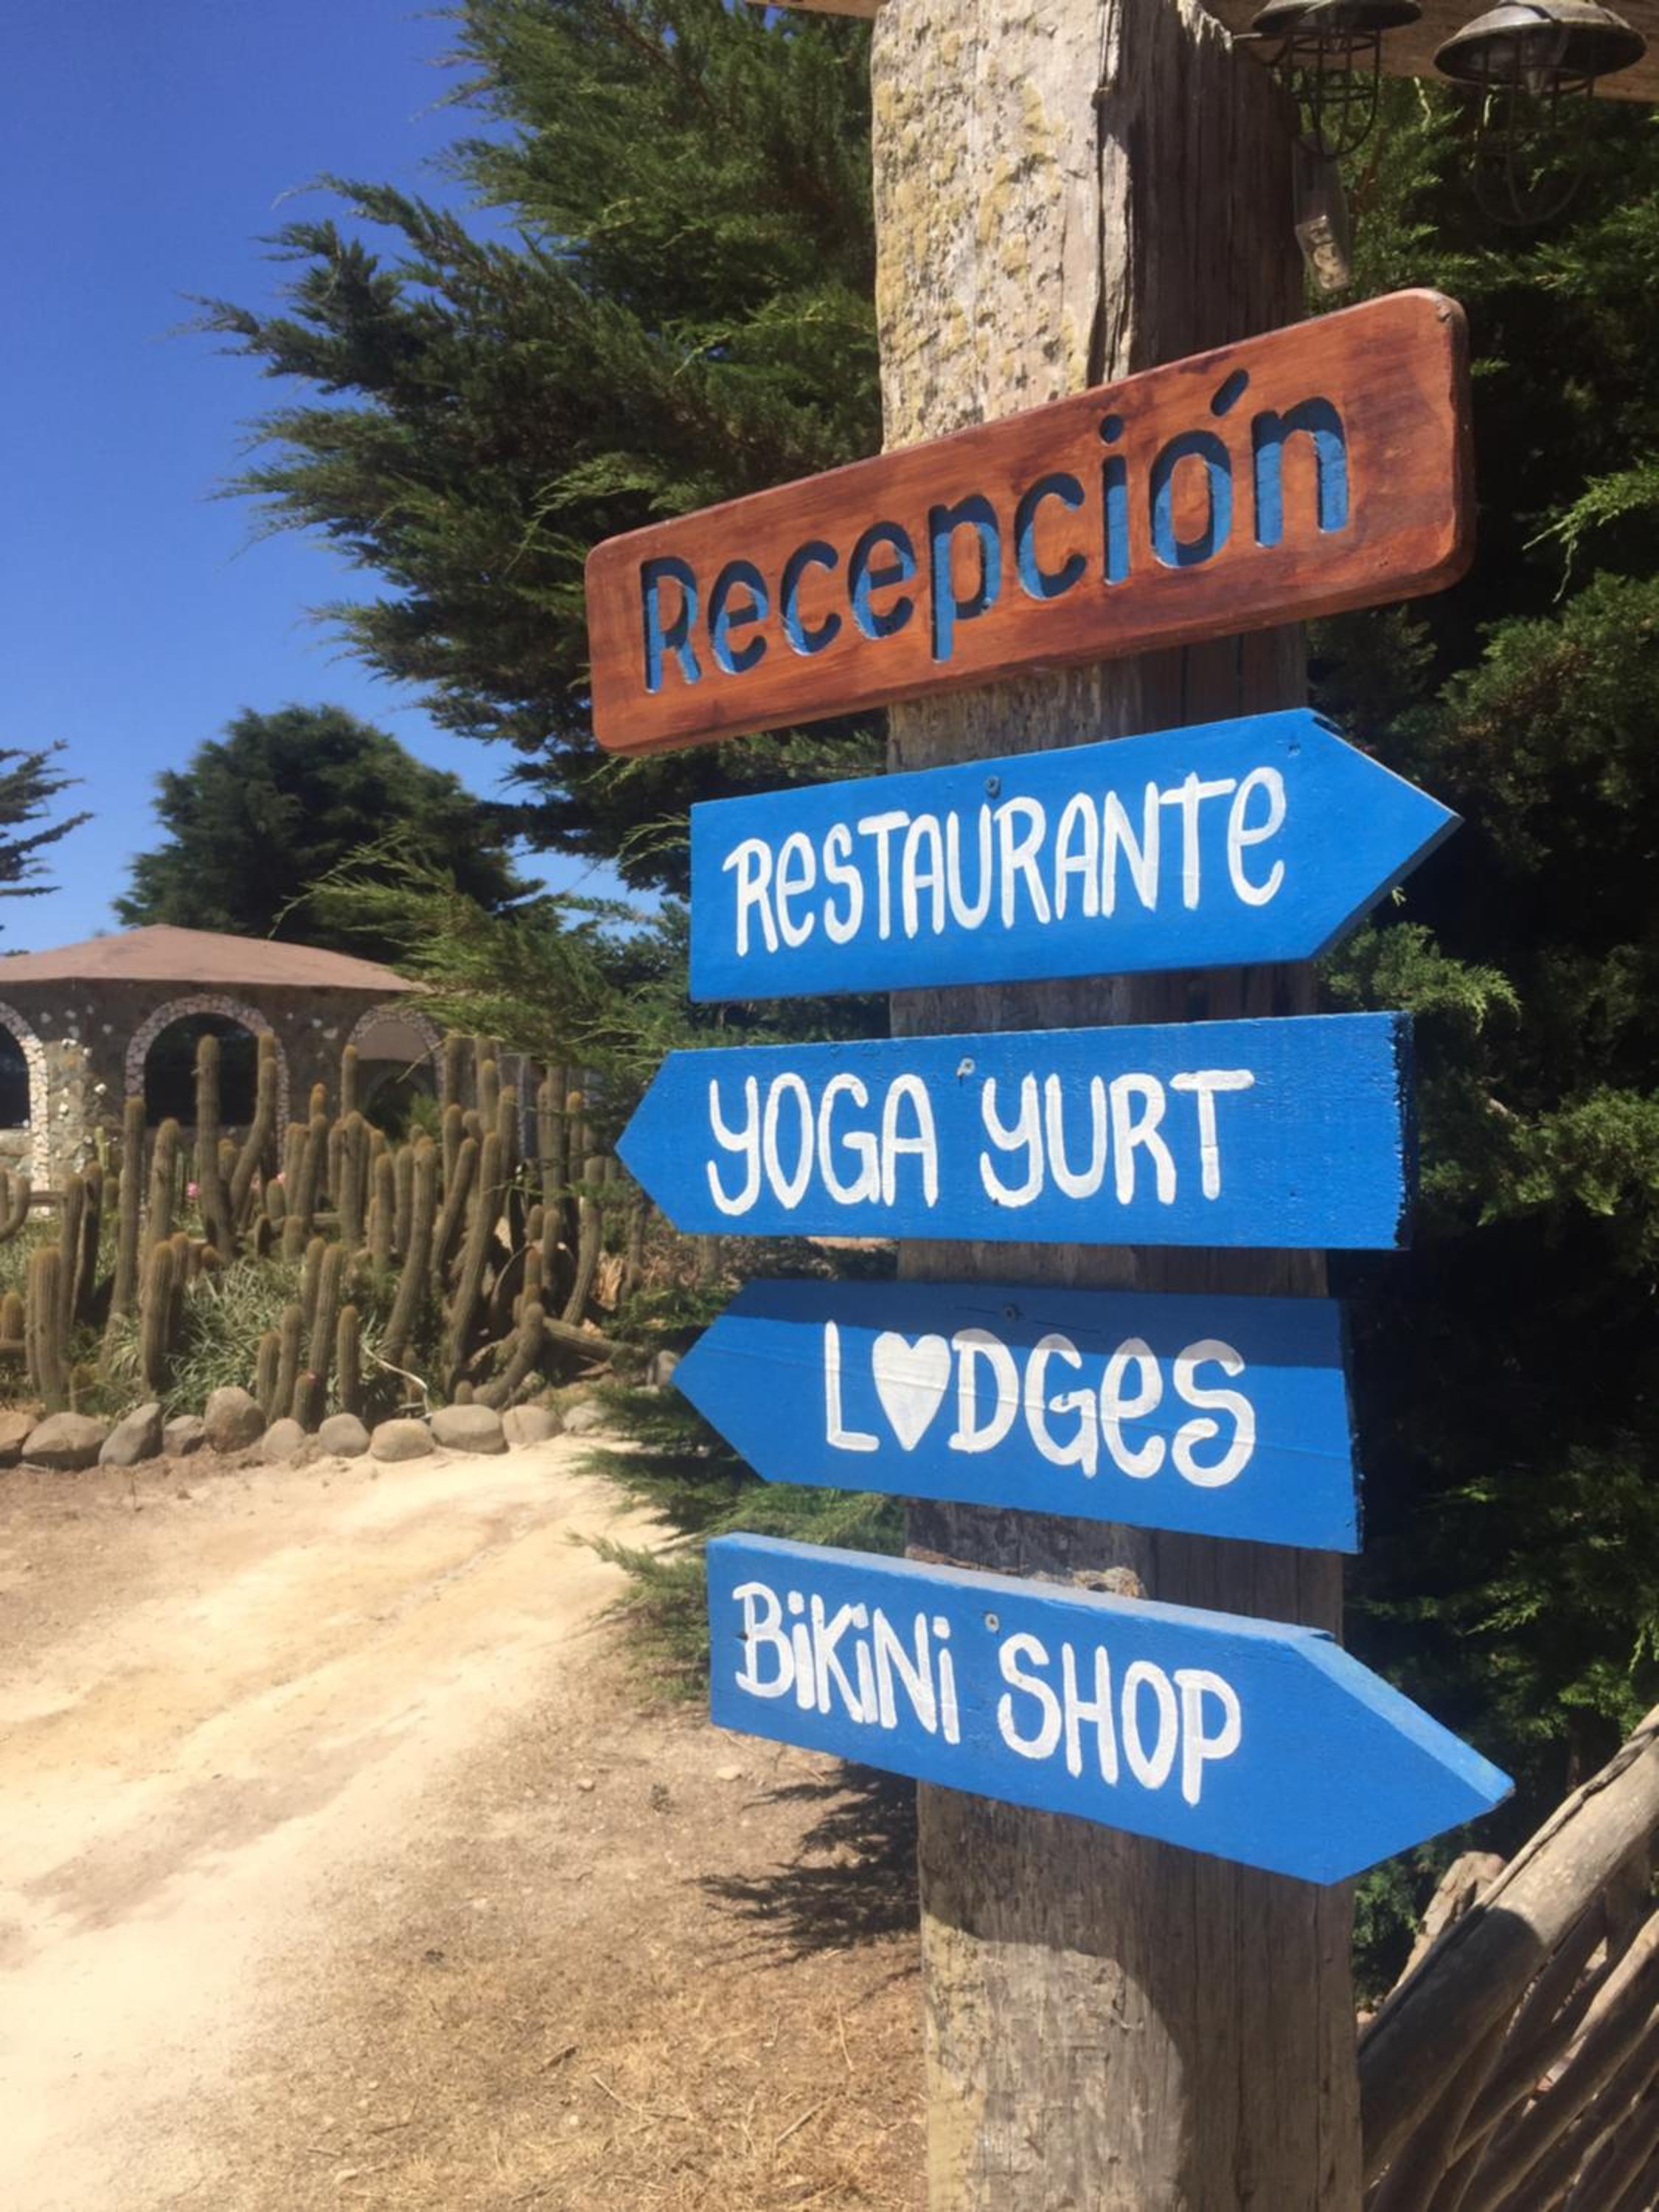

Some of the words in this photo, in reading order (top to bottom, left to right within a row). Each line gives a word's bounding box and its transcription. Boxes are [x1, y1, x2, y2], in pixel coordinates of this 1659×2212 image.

[639, 368, 1350, 693] Recepción
[707, 1071, 939, 1216] YOGA
[980, 1069, 1256, 1209] YURT
[996, 1632, 1242, 1806] SHOP
